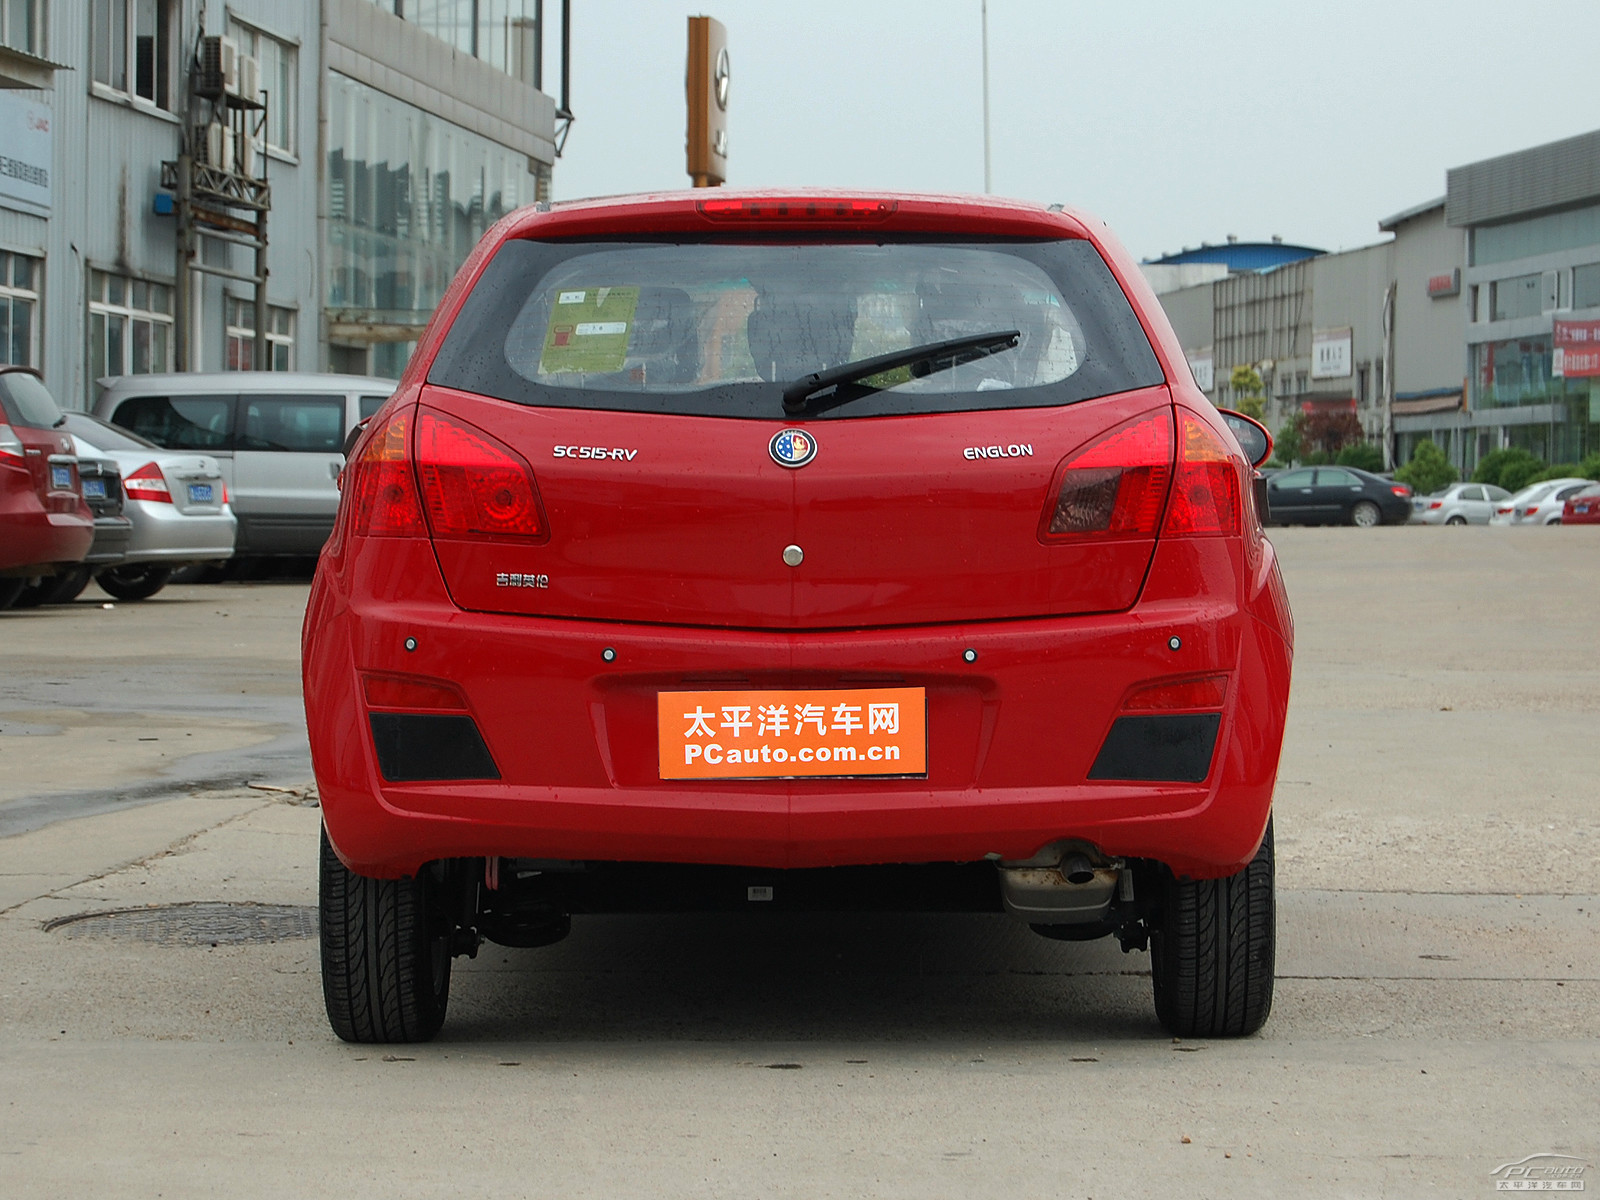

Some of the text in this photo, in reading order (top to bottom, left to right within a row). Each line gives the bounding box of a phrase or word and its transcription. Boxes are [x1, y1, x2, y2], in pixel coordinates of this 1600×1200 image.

[553, 445, 638, 461] SC515-RV
[963, 443, 1034, 461] ENGLON
[683, 703, 900, 738] 太平洋汽车网
[684, 743, 900, 765] PCauto.com.cn
